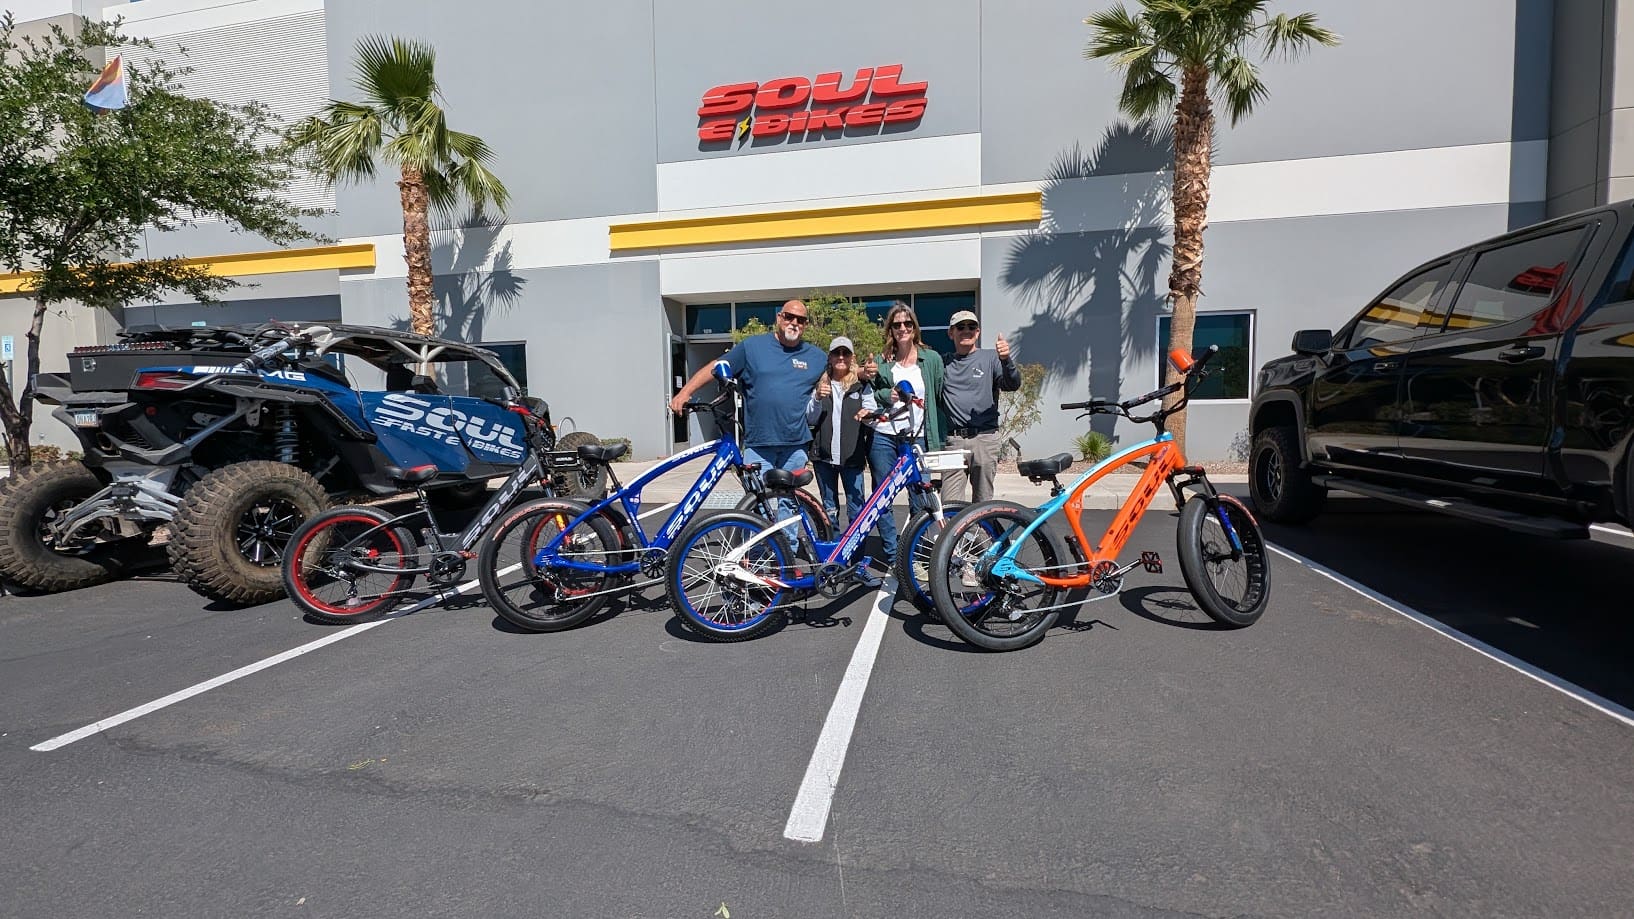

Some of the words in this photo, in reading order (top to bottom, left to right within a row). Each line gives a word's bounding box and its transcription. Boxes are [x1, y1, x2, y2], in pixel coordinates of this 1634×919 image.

[697, 64, 928, 116] SOUL
[375, 393, 525, 452] SOUL
[462, 464, 537, 549] SOUL
[666, 450, 735, 540] SOUL
[842, 464, 913, 560] SOUL
[1112, 453, 1177, 550] SOUL
